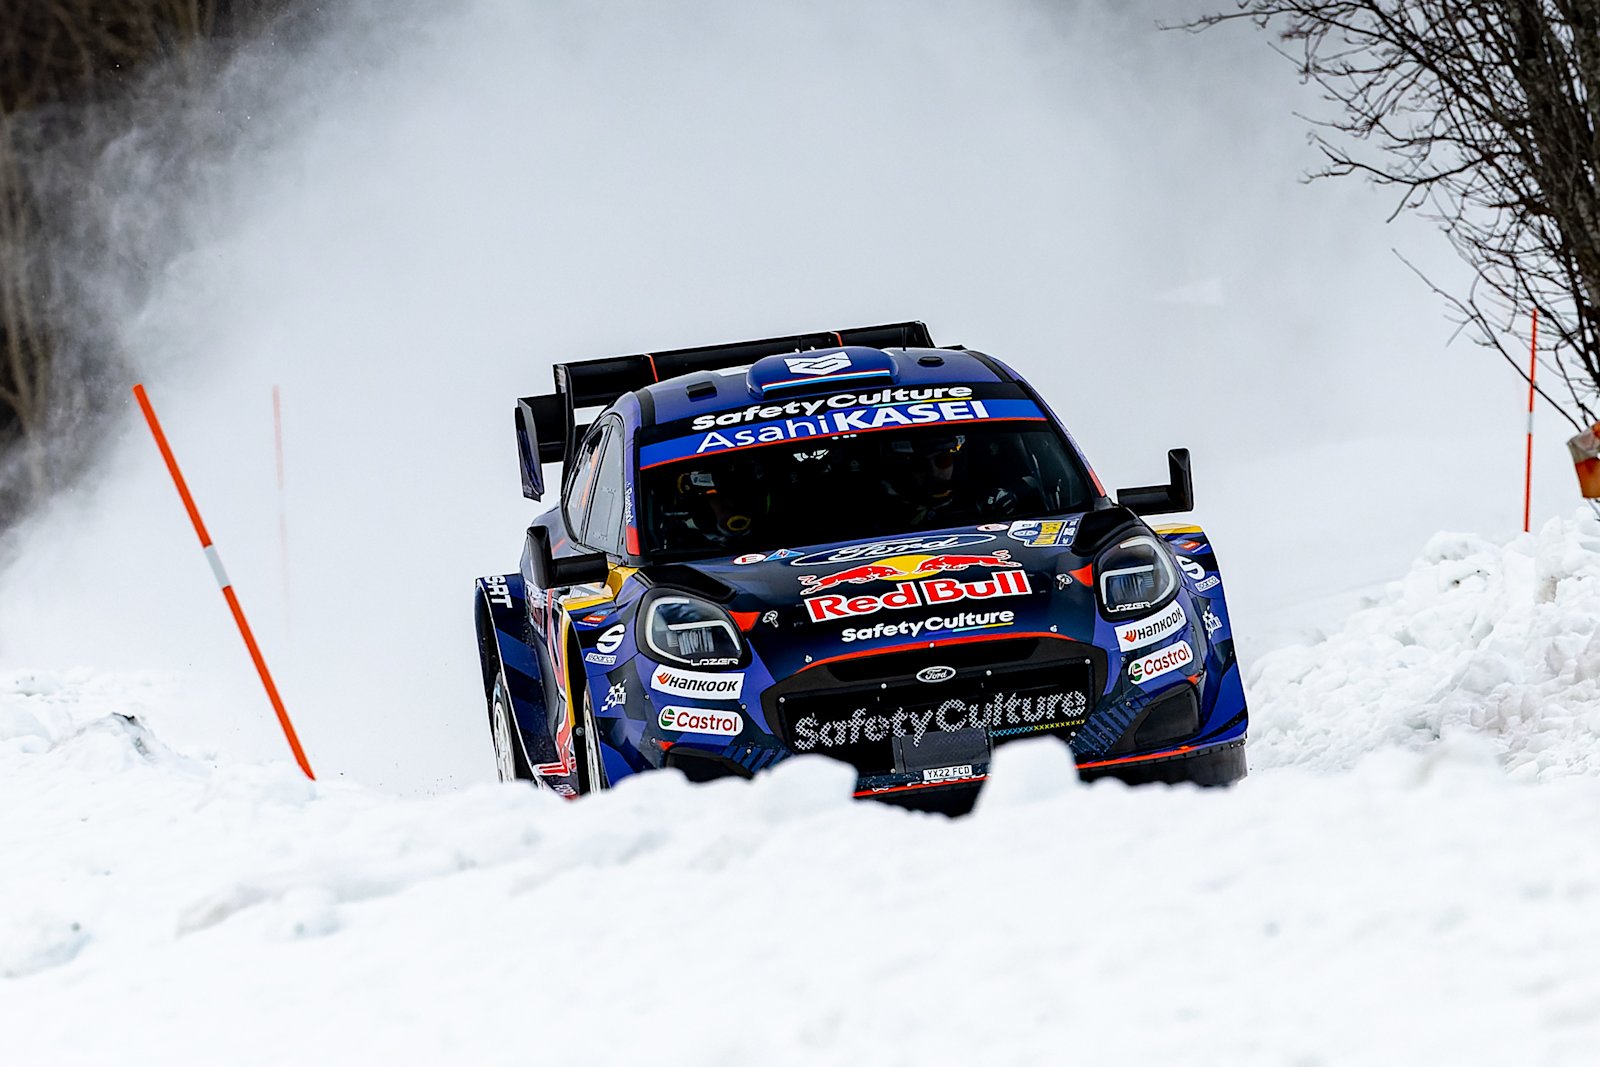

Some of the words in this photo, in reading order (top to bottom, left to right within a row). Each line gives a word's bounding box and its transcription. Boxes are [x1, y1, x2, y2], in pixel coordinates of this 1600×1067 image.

[692, 386, 972, 430] SafetyCulture
[828, 536, 960, 561] Ford
[804, 582, 922, 623] Red
[919, 570, 1033, 605] Bull
[841, 610, 1014, 642] SafetyCulture
[925, 669, 948, 680] Ford
[1143, 644, 1190, 675] Castrol
[676, 711, 738, 732] Castrol
[795, 690, 1086, 751] SafetyCulture
[927, 768, 950, 779] YX22
[952, 766, 970, 776] FCD
